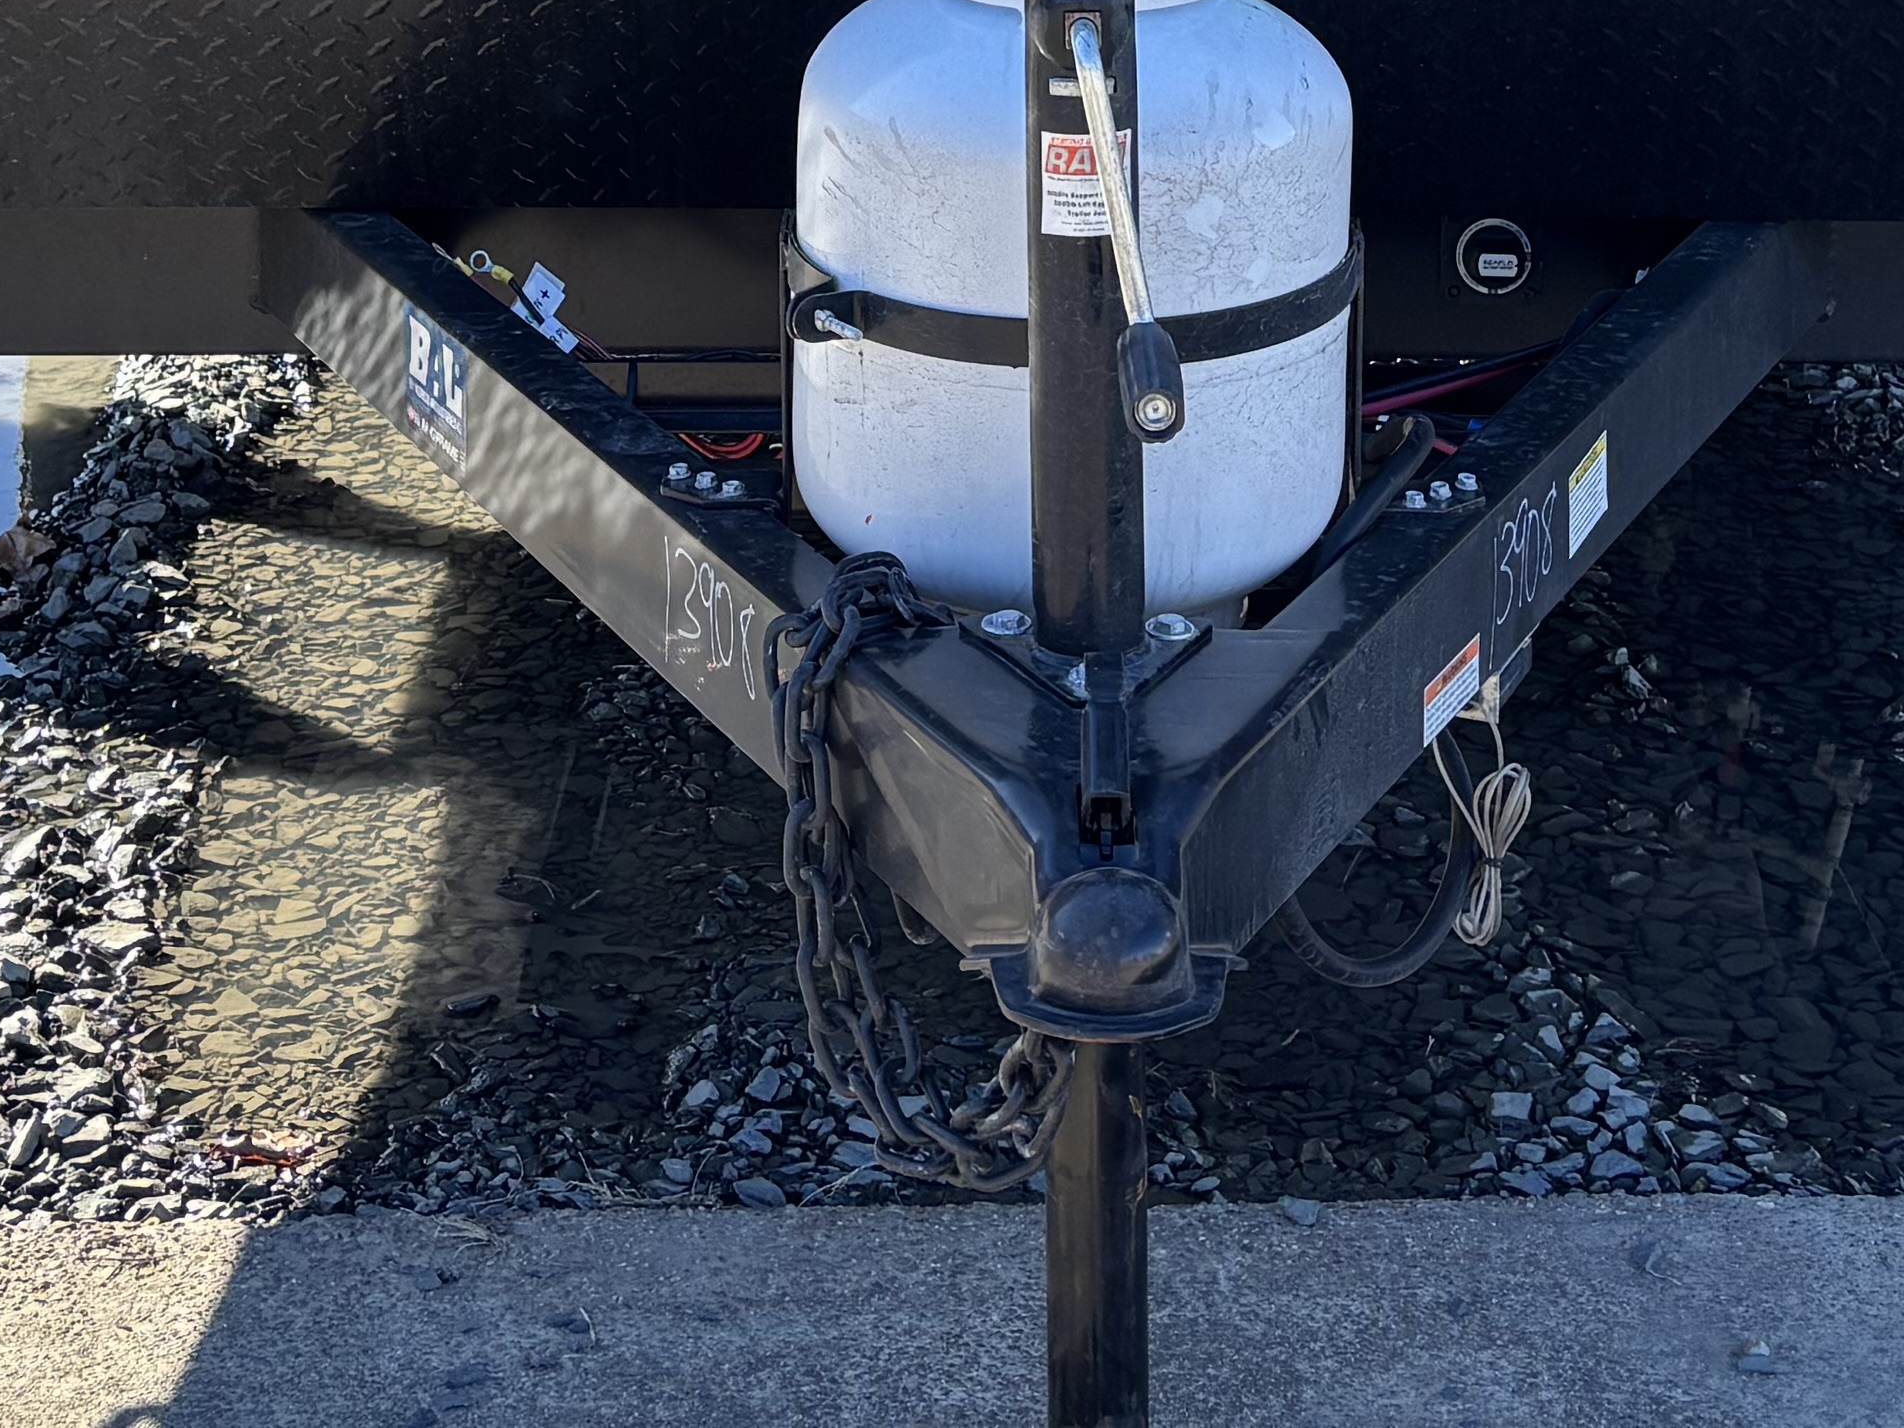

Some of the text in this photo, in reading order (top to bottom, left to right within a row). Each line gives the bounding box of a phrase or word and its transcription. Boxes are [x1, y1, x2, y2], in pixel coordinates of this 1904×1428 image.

[1047, 147, 1123, 174] RA
[663, 535, 756, 700] 13908
[1488, 480, 1558, 670] 13908
